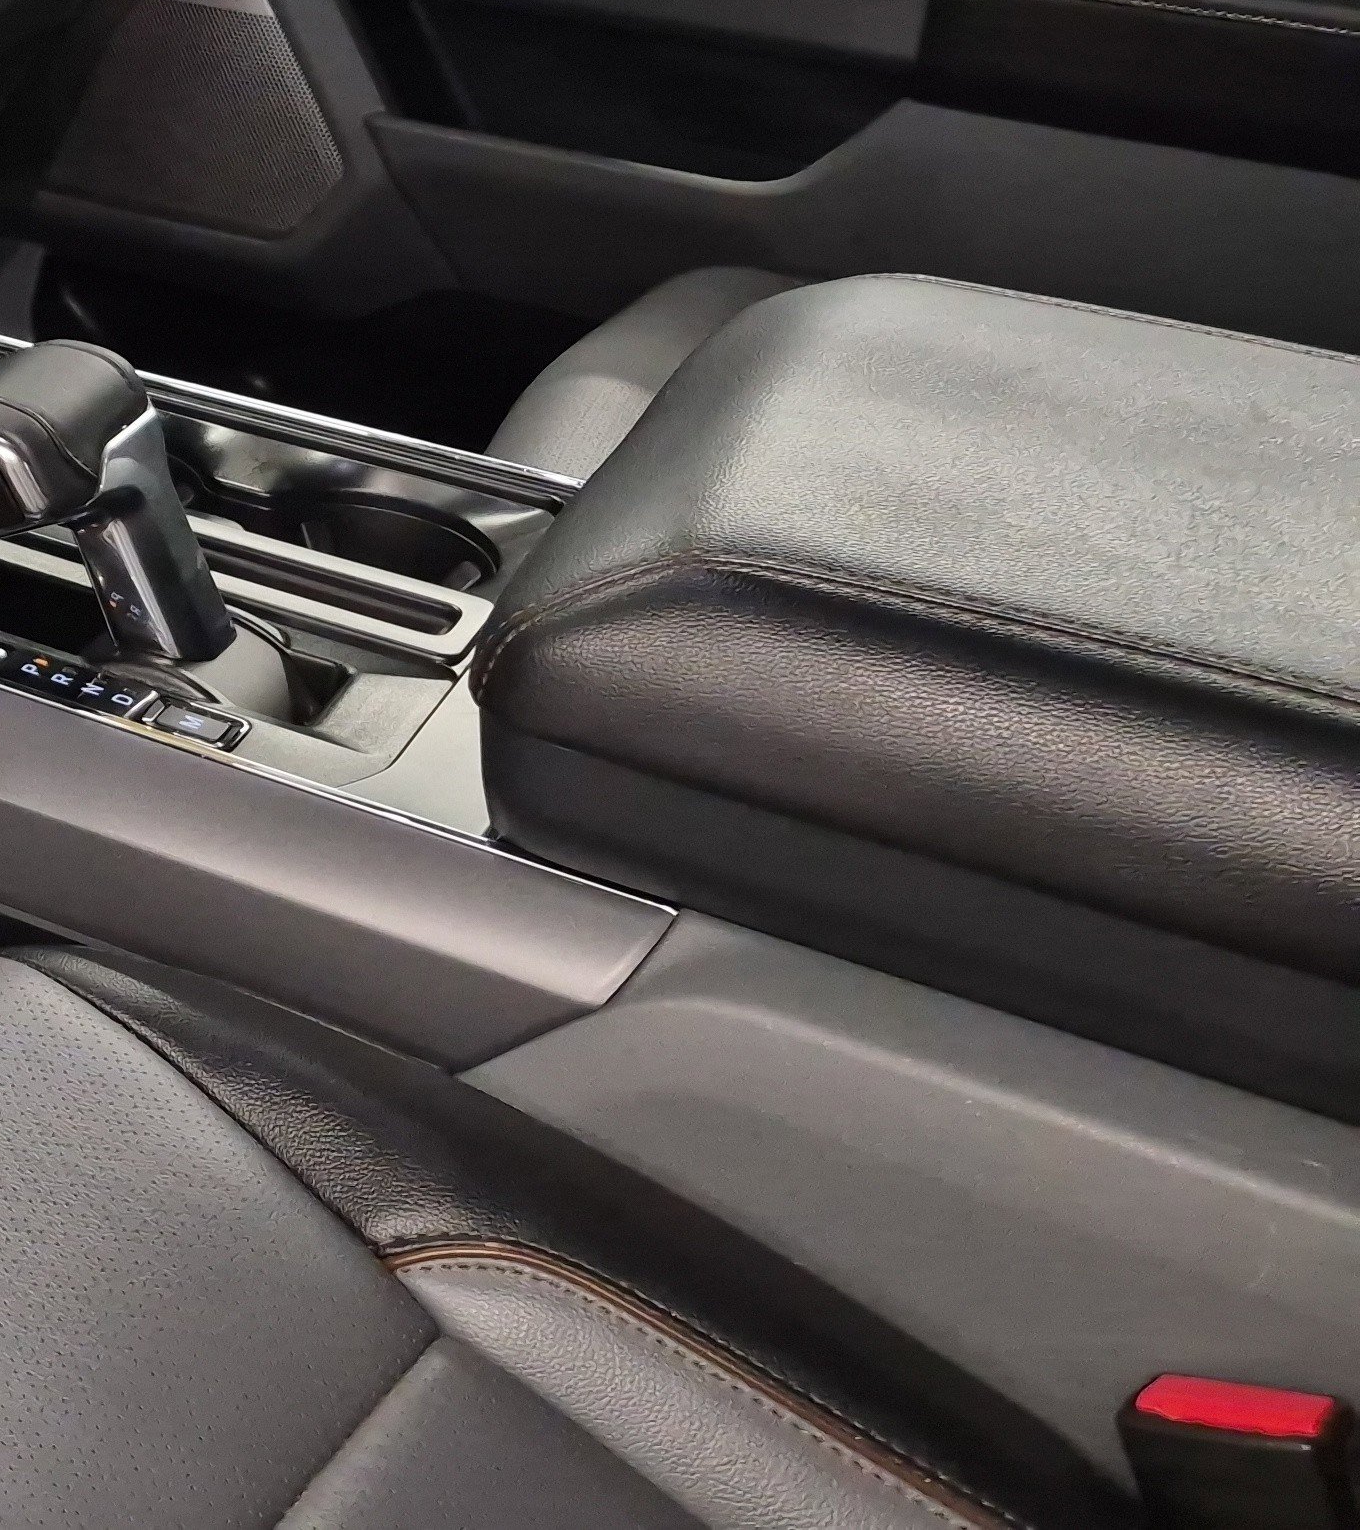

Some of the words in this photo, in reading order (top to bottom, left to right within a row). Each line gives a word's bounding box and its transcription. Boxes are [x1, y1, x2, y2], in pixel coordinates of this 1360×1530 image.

[21, 663, 40, 677] P
[51, 672, 74, 687] R
[81, 682, 105, 697] N
[111, 693, 134, 707] D
[180, 715, 204, 730] M
